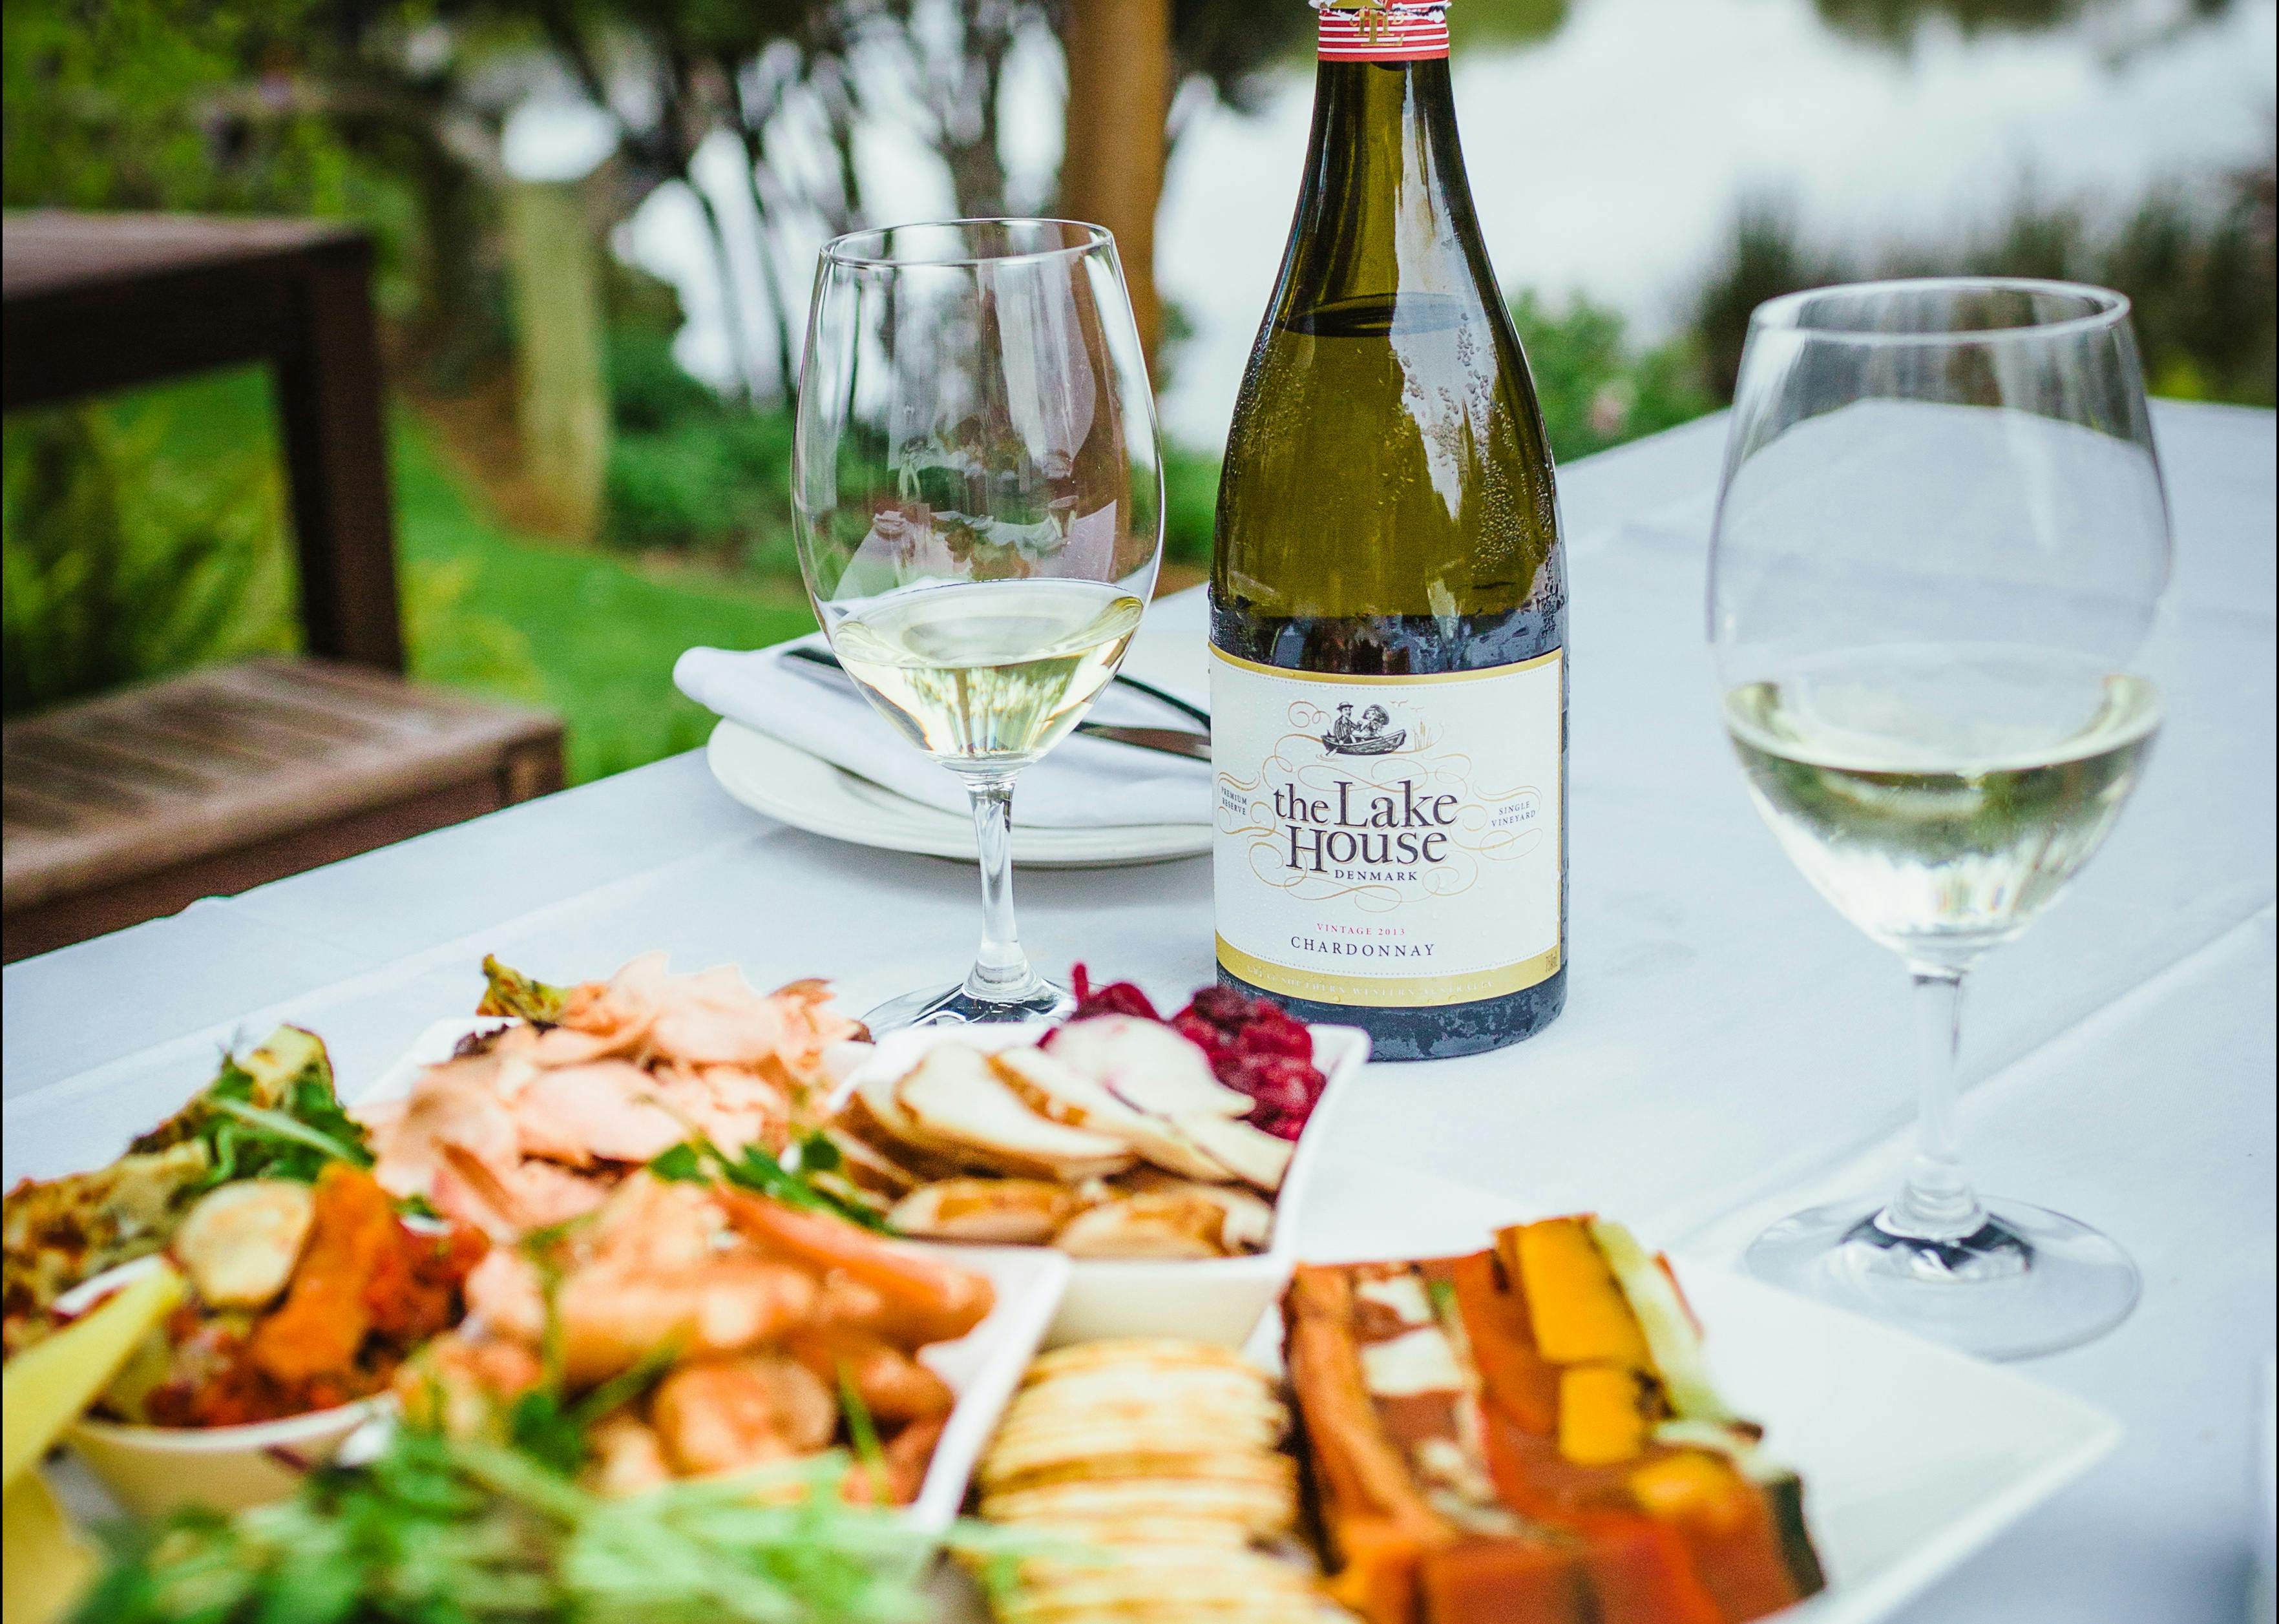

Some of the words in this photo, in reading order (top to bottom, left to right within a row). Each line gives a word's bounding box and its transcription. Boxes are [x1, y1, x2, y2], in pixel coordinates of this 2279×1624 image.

[1221, 786, 1247, 806] PREMIUM
[1273, 784, 1329, 824] the
[1333, 780, 1458, 828] Lake
[1222, 796, 1246, 815] RESERVE
[1498, 801, 1530, 815] SINGLE
[1491, 810, 1536, 827] VINEYARD
[1335, 869, 1417, 880] DENMARK
[1317, 923, 1372, 935] VINTAGE
[1291, 937, 1434, 956] CHARDONNAY
